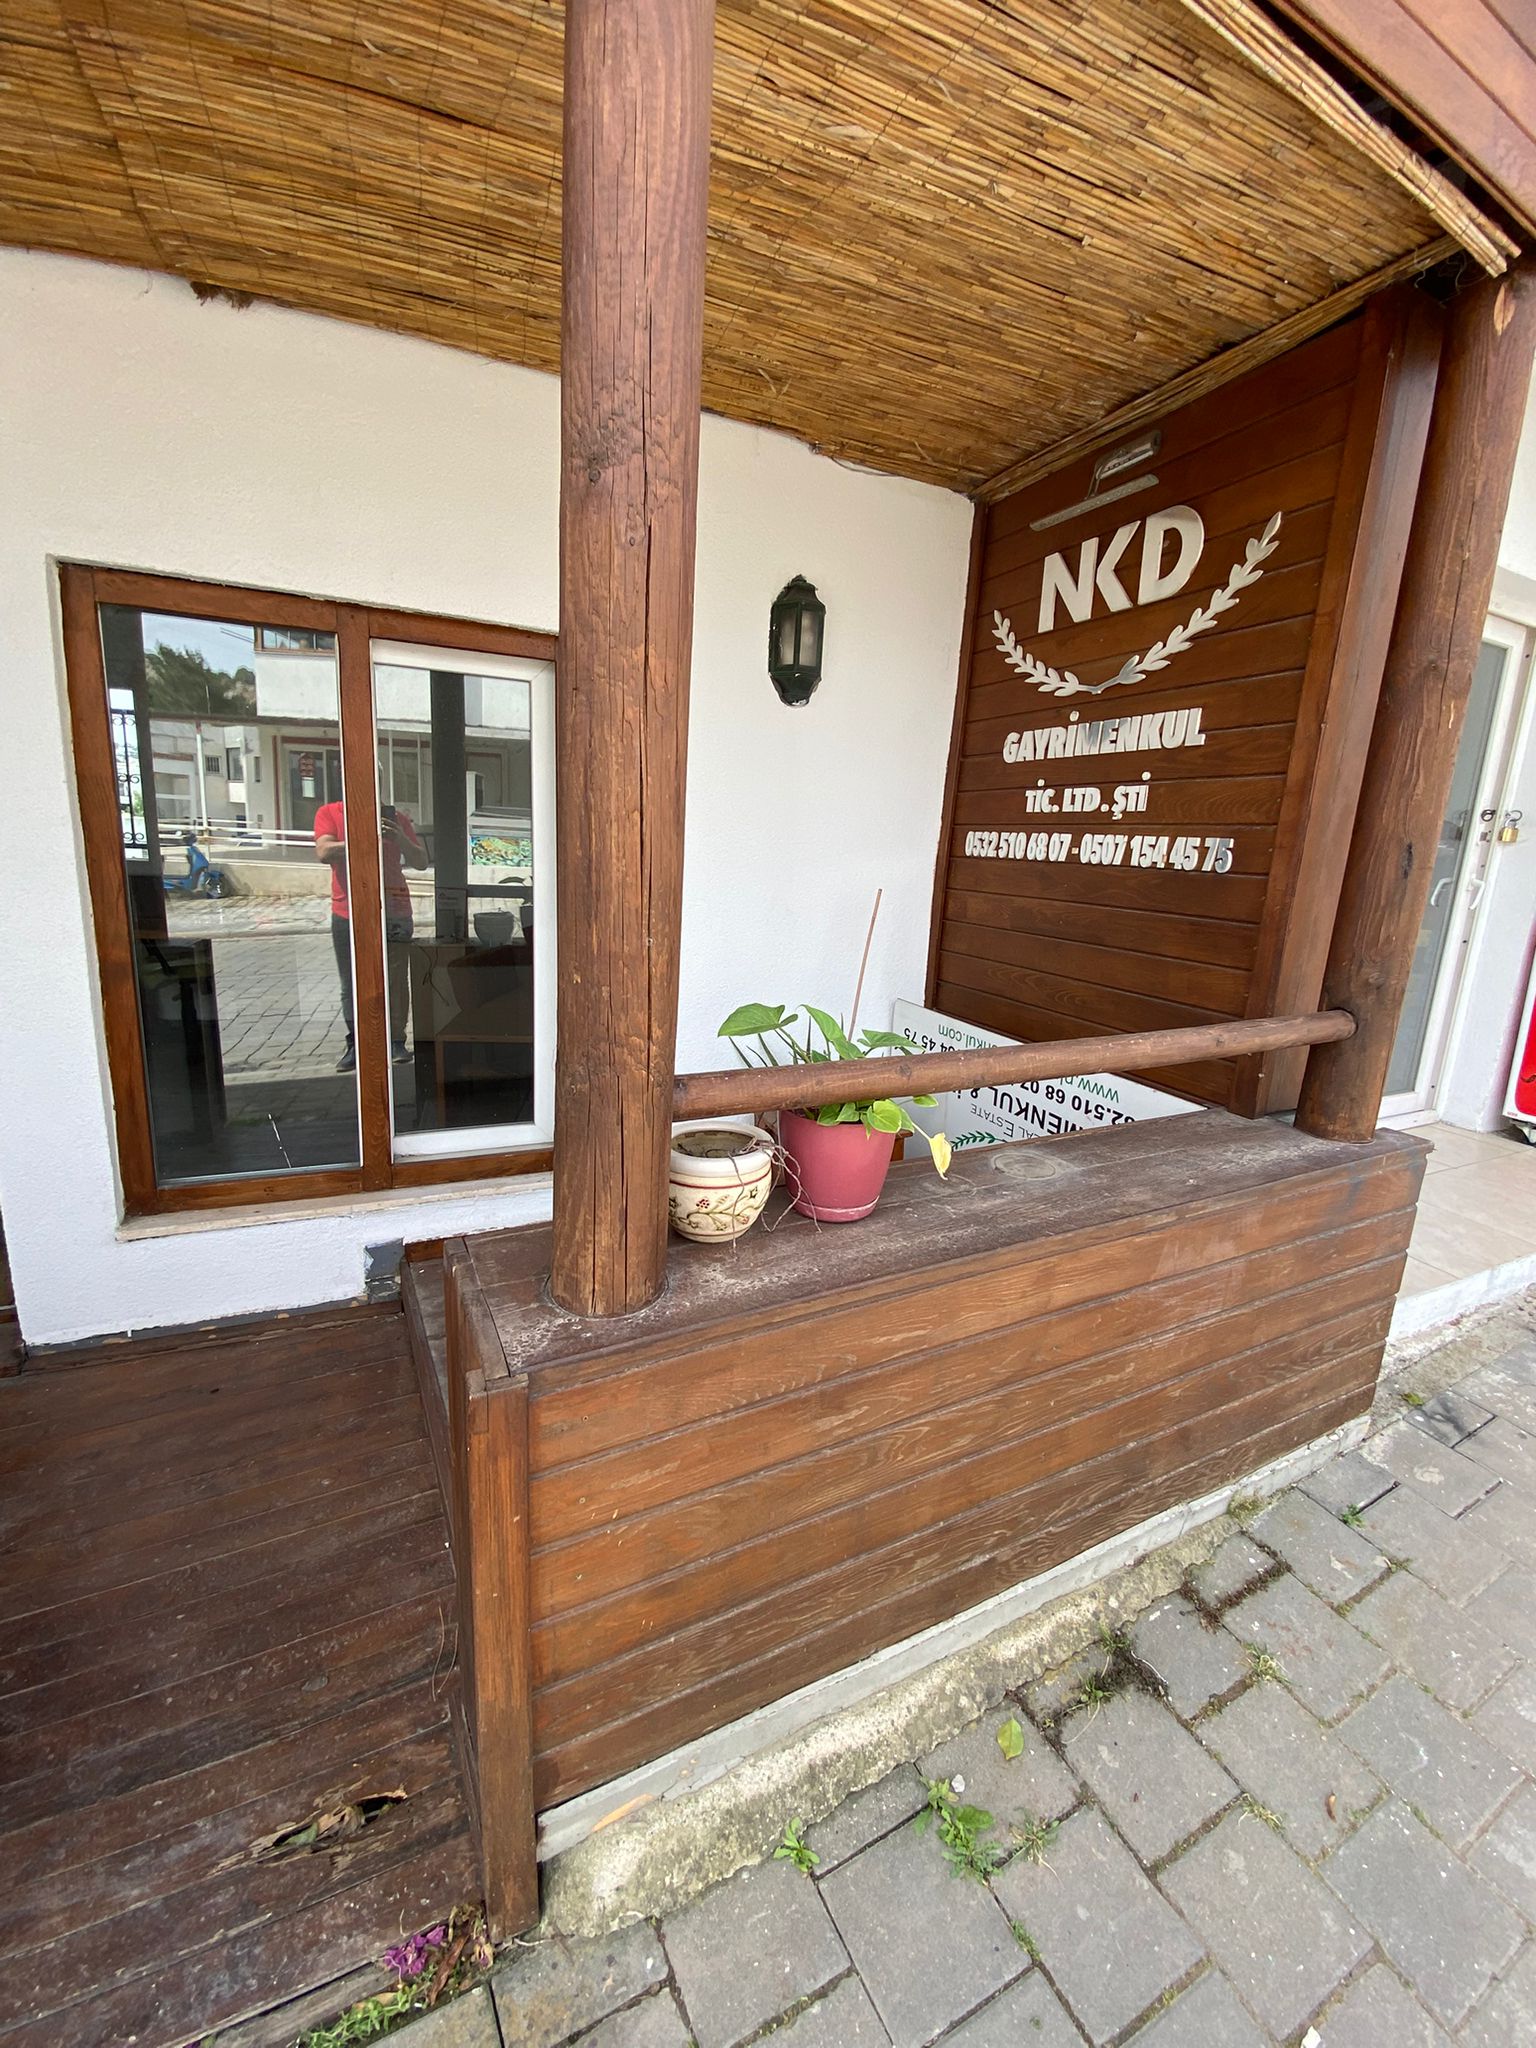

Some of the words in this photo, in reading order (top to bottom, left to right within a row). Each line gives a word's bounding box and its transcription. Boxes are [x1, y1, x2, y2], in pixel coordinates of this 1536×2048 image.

[1038, 505, 1205, 633] NKD
[1002, 707, 1206, 763] GAYRİMENKUL
[965, 831, 999, 857] 0532
[998, 832, 1027, 860] 510
[1026, 832, 1049, 861] 68
[1048, 832, 1072, 861] 07
[1079, 833, 1128, 866] 0507
[1130, 835, 1169, 869] 154
[1168, 836, 1201, 871] 45
[1201, 837, 1234, 874] 75
[904, 1028, 917, 1045] 75
[921, 1035, 936, 1051] 45
[1045, 1084, 1065, 1104] 68
